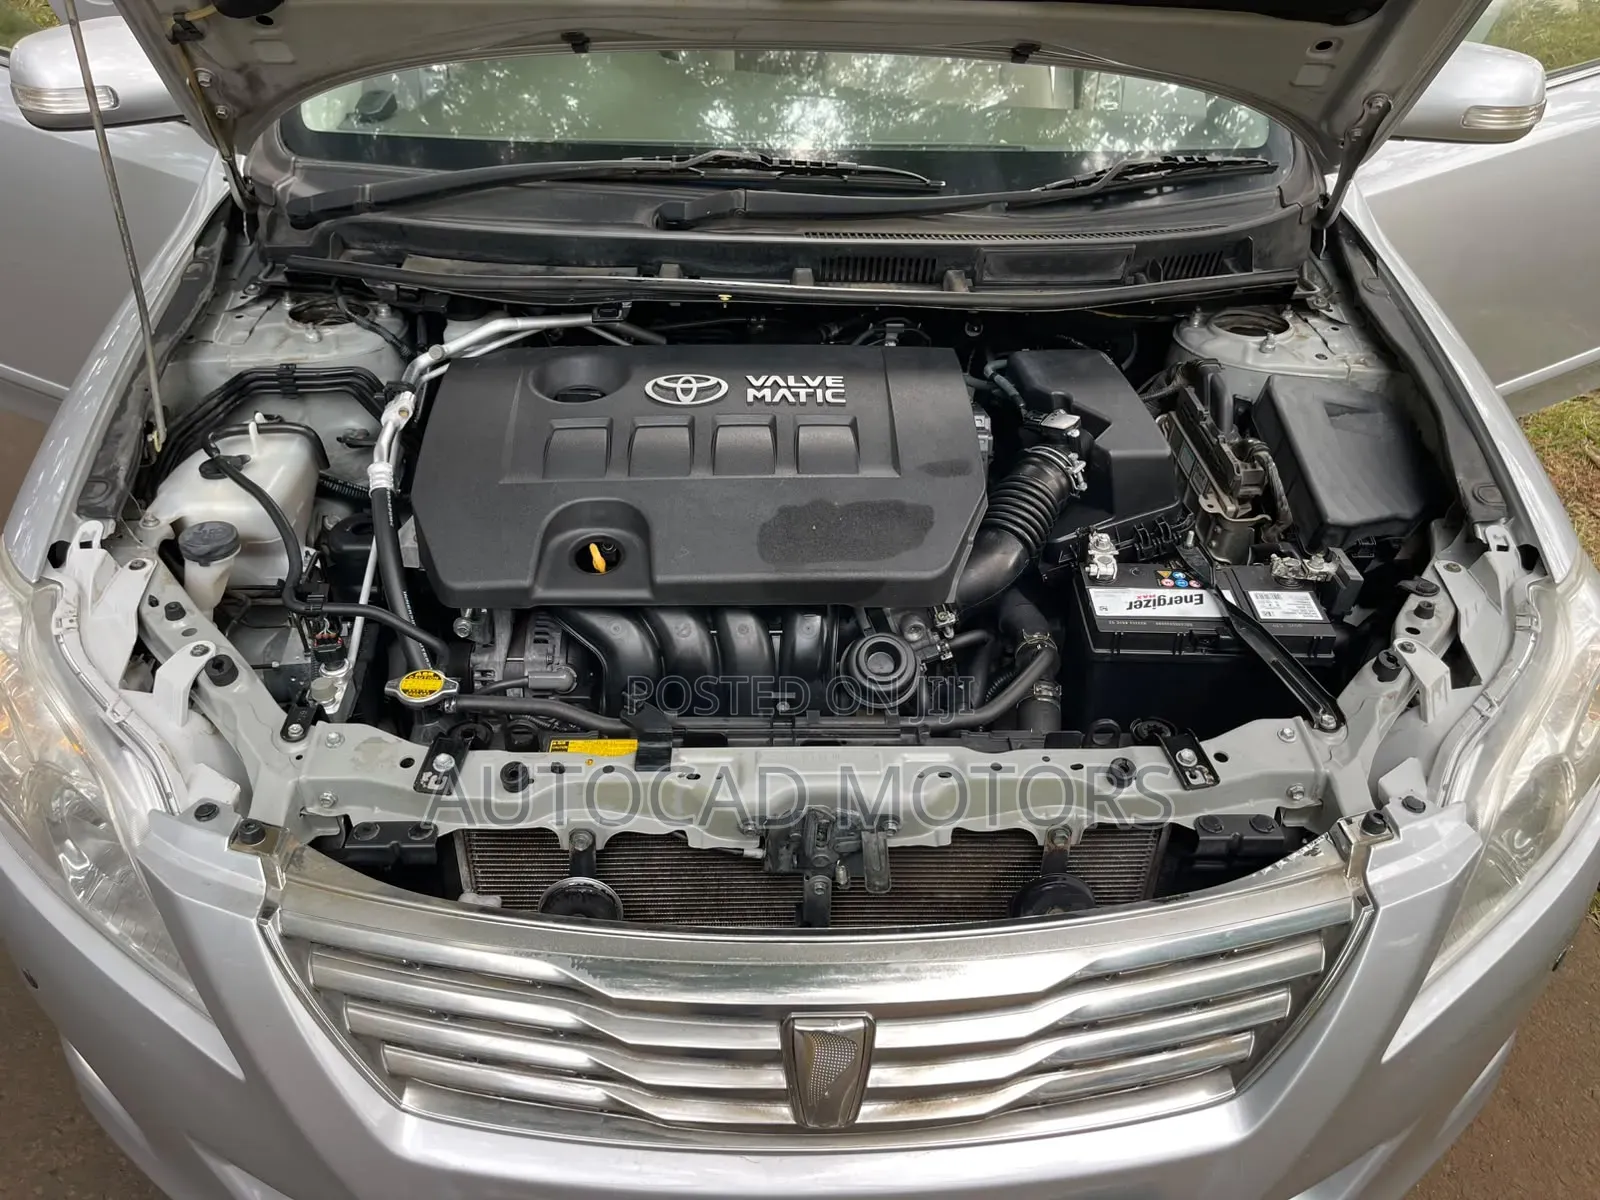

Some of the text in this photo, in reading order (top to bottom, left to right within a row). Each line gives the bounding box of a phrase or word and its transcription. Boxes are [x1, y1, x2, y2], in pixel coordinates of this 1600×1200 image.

[745, 375, 845, 388] VALVE
[746, 388, 847, 404] MATIC
[1126, 593, 1204, 611] Energizer
